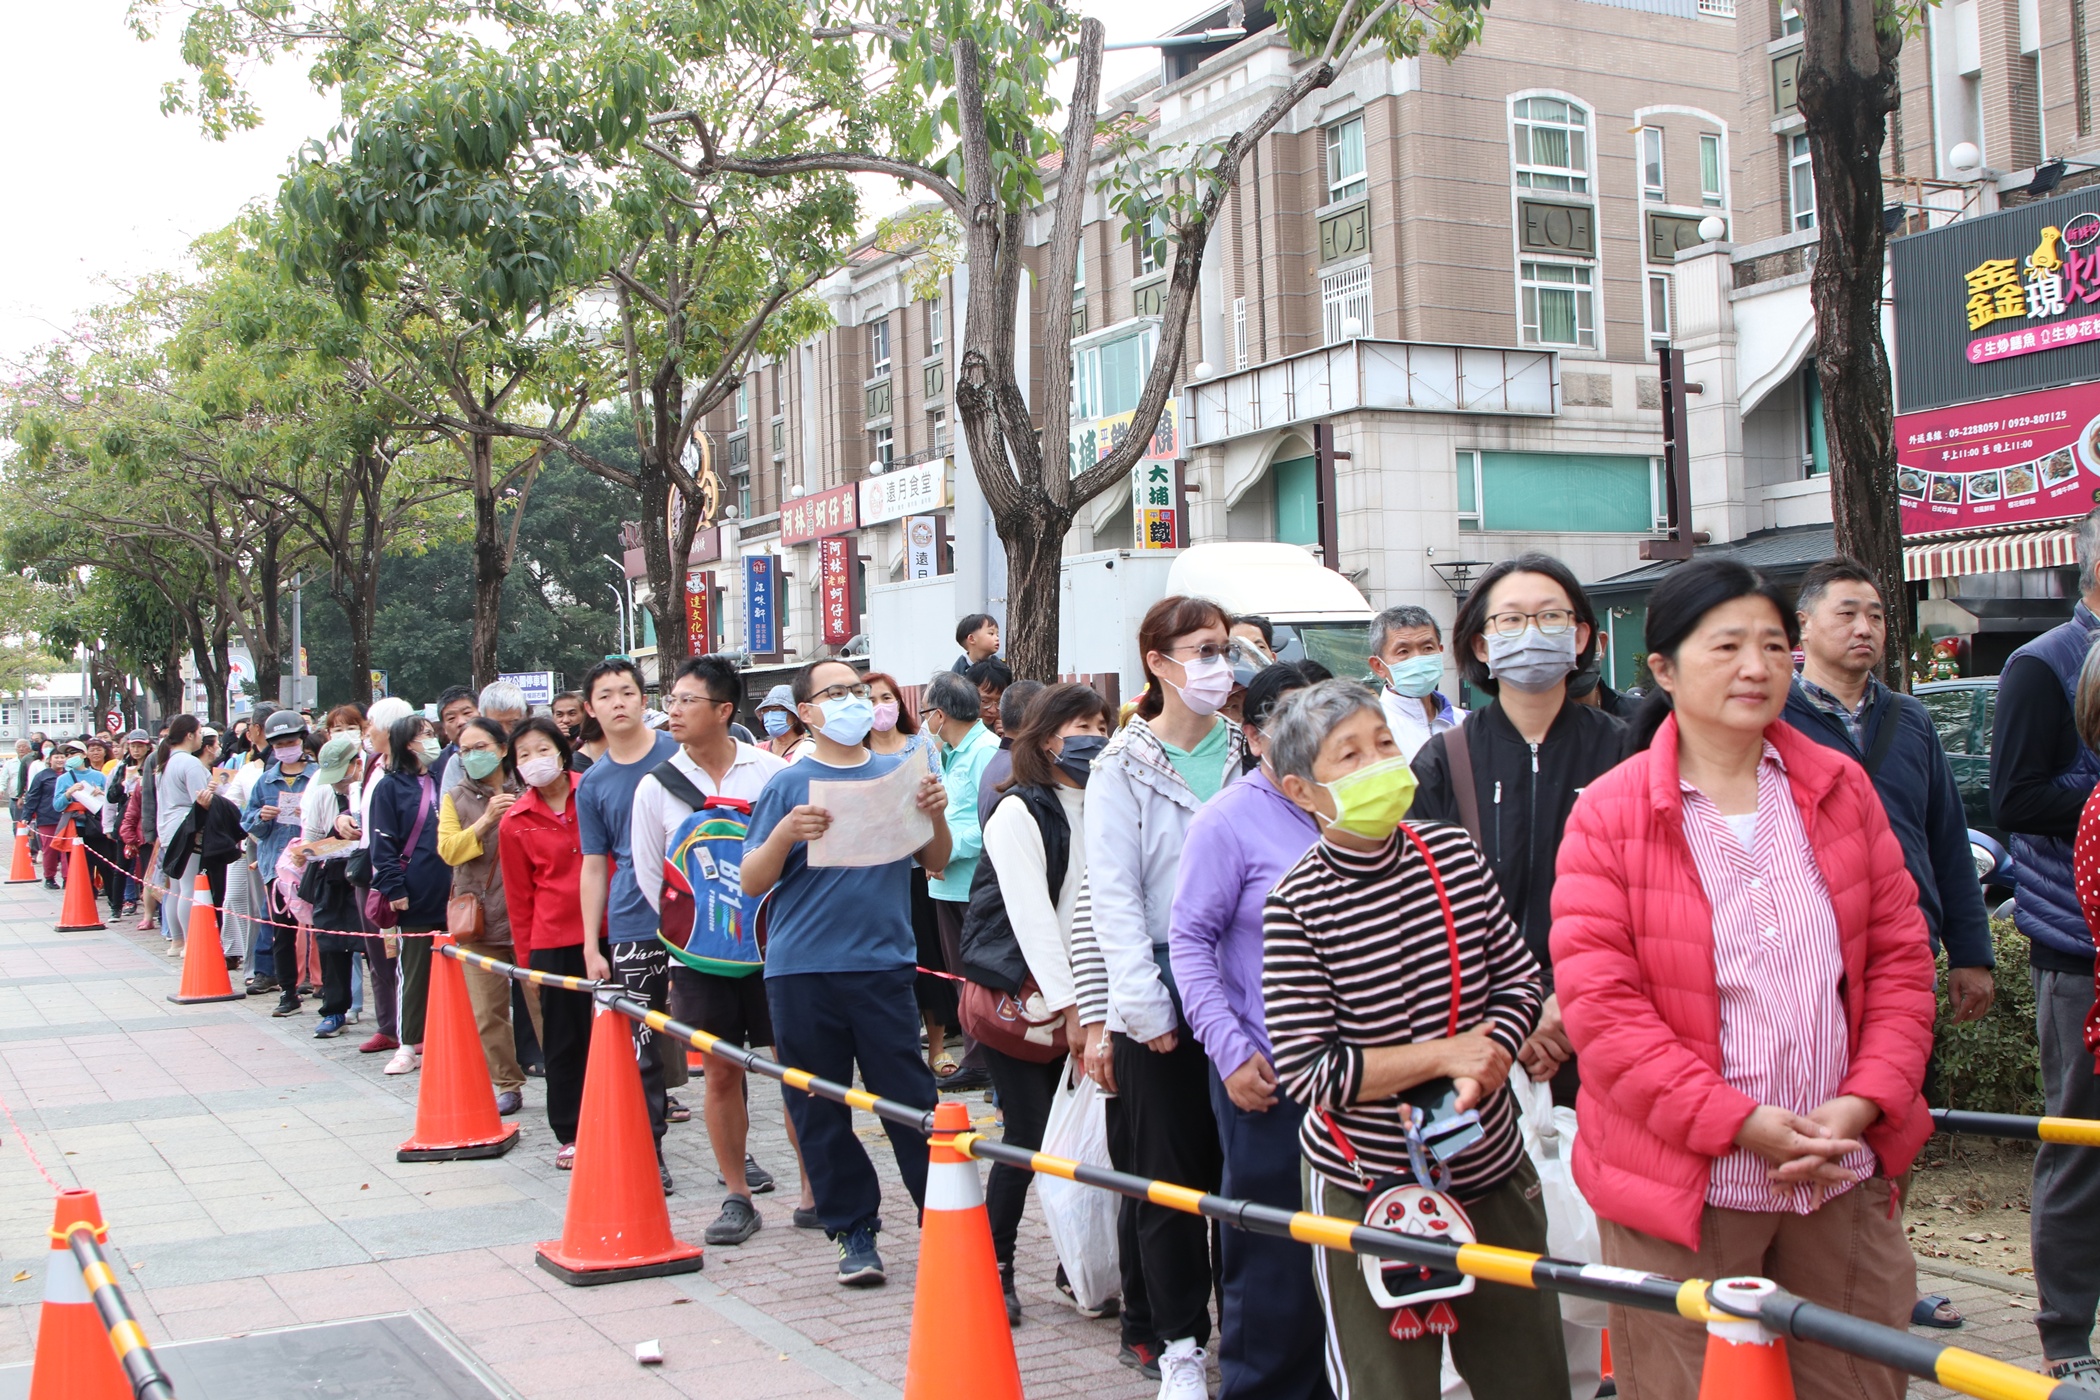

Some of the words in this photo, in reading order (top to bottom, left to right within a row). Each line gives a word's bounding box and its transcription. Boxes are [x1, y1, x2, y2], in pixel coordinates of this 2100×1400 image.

[2008, 410, 2067, 429] 0929-807125
[886, 470, 932, 504] 遠月食堂
[1148, 464, 1169, 506] 大埔
[718, 859, 742, 909] BF1
